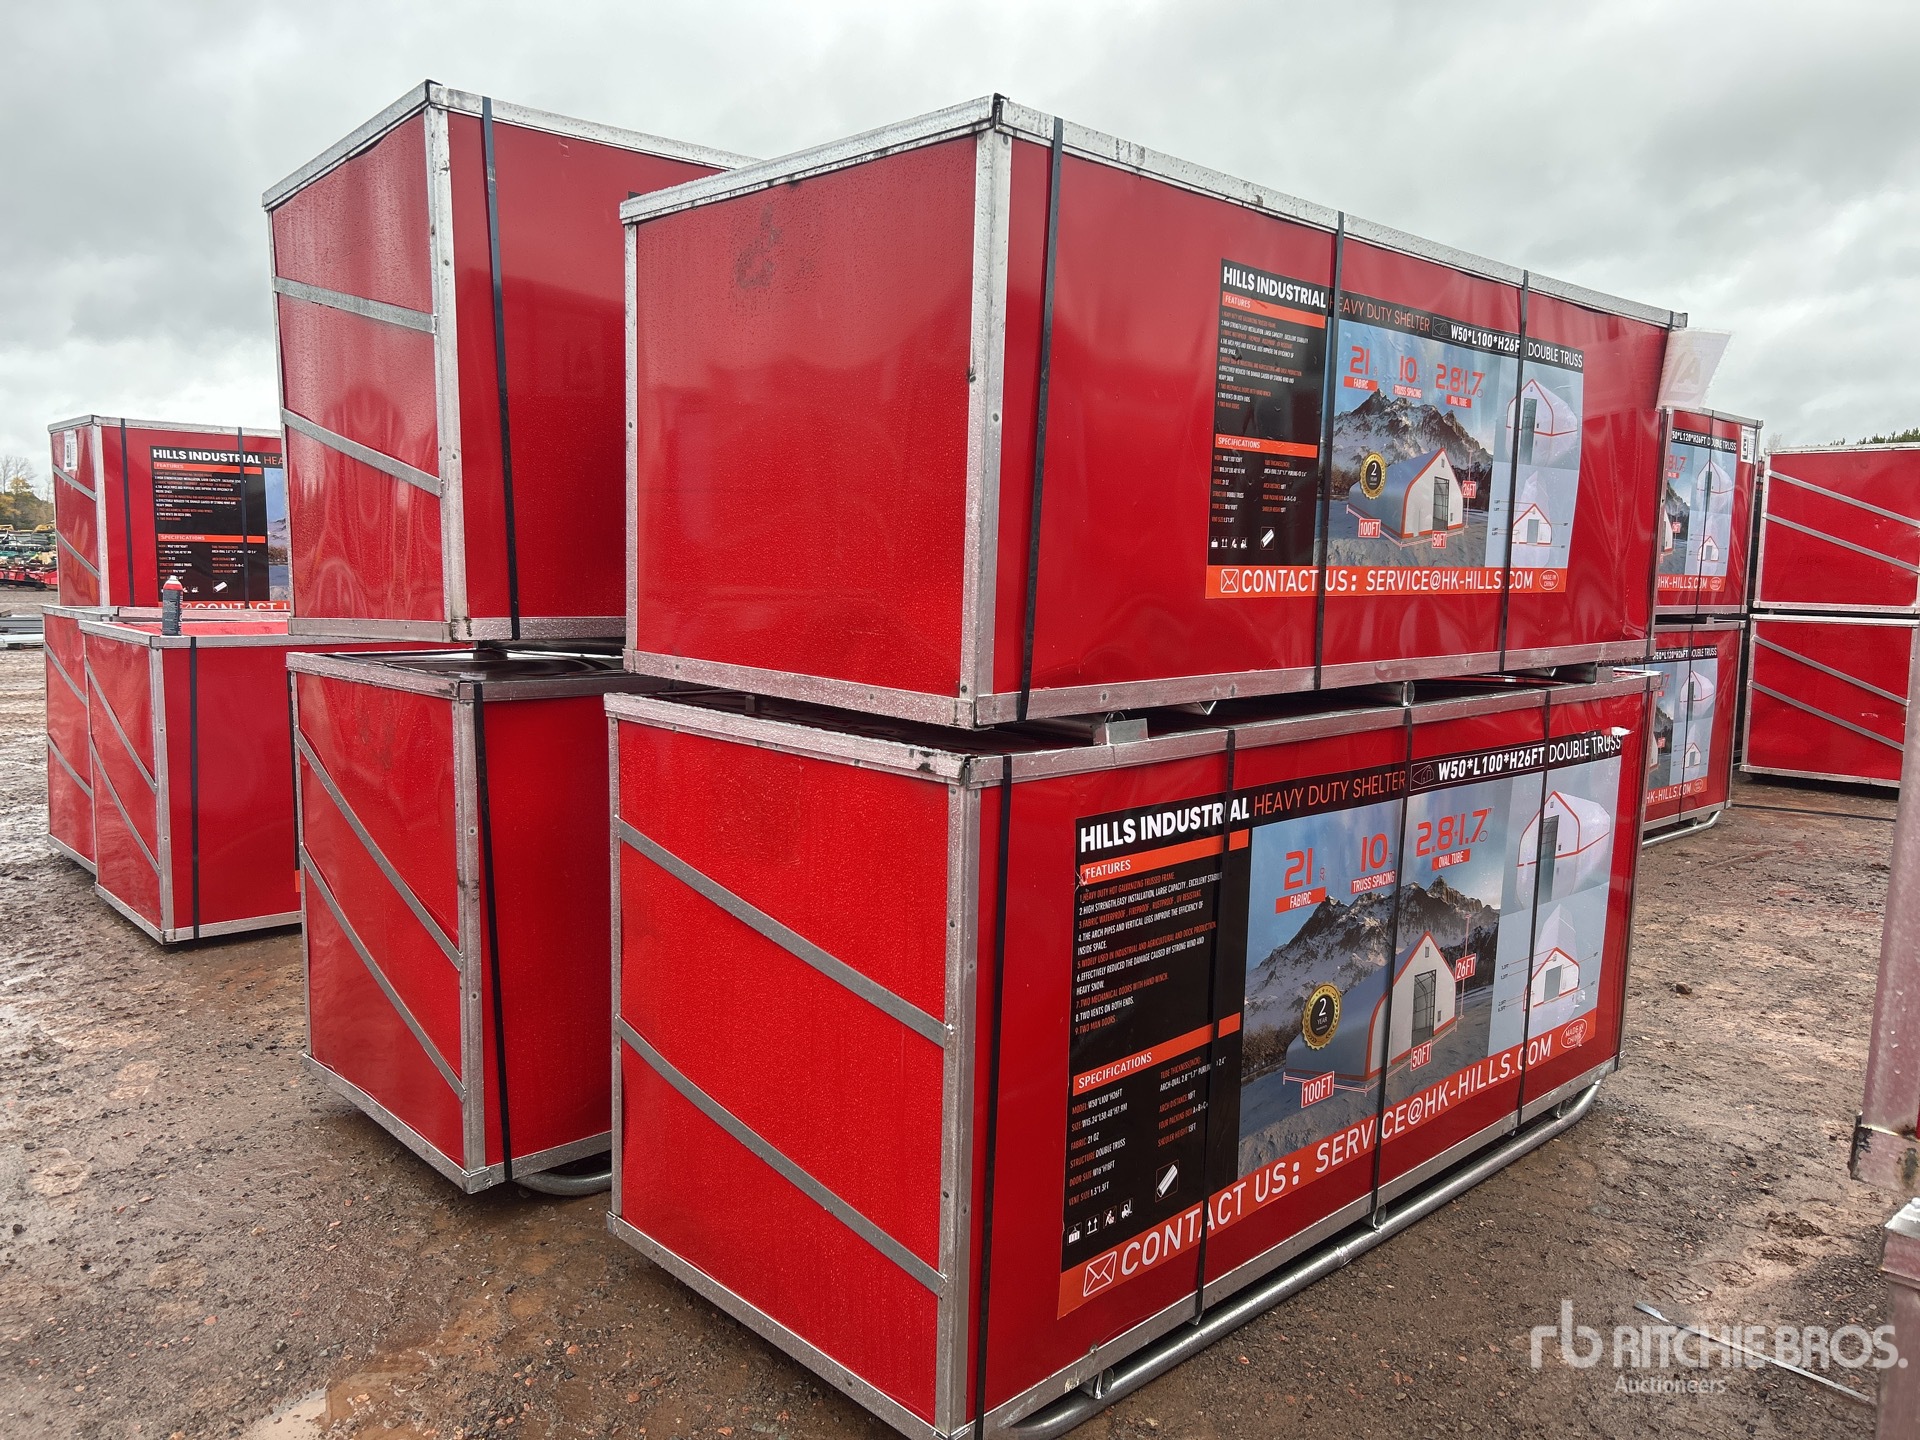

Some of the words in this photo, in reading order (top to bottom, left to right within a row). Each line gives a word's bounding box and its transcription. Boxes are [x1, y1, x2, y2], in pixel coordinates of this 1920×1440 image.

[1224, 266, 1254, 290] HILLS
[1256, 276, 1326, 308] INDUSTRIAL
[1366, 302, 1392, 324] DUTY
[1394, 308, 1430, 332] SHELTER
[1225, 295, 1251, 308] FEATURES
[1450, 324, 1520, 352] W50L100H26F
[1350, 346, 1370, 376] 21
[1528, 342, 1558, 362] DOUBLE
[1560, 350, 1583, 368] TRUSS
[1400, 356, 1417, 383] 10
[1218, 437, 1260, 449] SPECIFICATIONS
[1722, 440, 1737, 452] TRUSS
[153, 449, 186, 460] HILLS
[189, 451, 261, 464] INDUSTRIAL
[1371, 462, 1377, 476] 2
[1360, 521, 1380, 536] 100FT
[1432, 532, 1446, 548] 50FT
[1242, 569, 1318, 593] CONTACT
[1548, 738, 1590, 763] DOUBLE
[1592, 733, 1622, 756] TRUSS
[1080, 818, 1136, 852] HILLS
[1140, 797, 1250, 840] INDUSTRAL
[1254, 787, 1304, 816] HEAVY
[1308, 780, 1350, 806] DUTY
[1352, 770, 1406, 799] SHELTER
[1361, 833, 1388, 872] 10
[1438, 854, 1450, 868] OVAL
[1452, 850, 1464, 864] TUBE
[1085, 859, 1132, 878] FEATURES
[1284, 847, 1314, 890] 21
[1156, 886, 1168, 898] LARGE
[1188, 876, 1207, 888] EXCELLENT
[1352, 877, 1373, 893] TRUSS
[1372, 870, 1396, 888] SPACING
[1091, 928, 1104, 938] ARCH
[1104, 924, 1116, 936] PIPES
[1116, 922, 1125, 933] AND
[1125, 918, 1143, 930] VERTICAL
[1144, 914, 1154, 926] LEGS
[1154, 910, 1171, 922] IMPROVE
[1178, 902, 1198, 916] EFFICIENCY
[1198, 900, 1204, 909] OF
[1076, 966, 1106, 982] 6.EFFECTIVELY
[1106, 960, 1126, 974] REDUCED
[1126, 958, 1134, 969] THE
[1134, 952, 1150, 966] DAMAGE
[1150, 947, 1166, 960] CAUSED
[1166, 946, 1171, 956] BY
[1172, 940, 1186, 954] STRONG
[1186, 938, 1197, 949] WIND
[1197, 936, 1205, 946] AND
[1078, 944, 1092, 956] INSIDE
[1456, 956, 1476, 979] 26FT
[1076, 984, 1090, 996] HEAVY
[1091, 990, 1118, 1006] MECHANICAL
[1118, 984, 1132, 996] DOORS
[1132, 980, 1144, 992] WITH
[1076, 1010, 1090, 1022] 8.TWO
[1090, 1005, 1104, 1018] VENTS
[1104, 1003, 1112, 1014] ON
[1112, 999, 1122, 1012] BOTH
[1319, 998, 1326, 1016] 2
[1090, 1020, 1101, 1031] MAN
[1317, 1016, 1328, 1025] YEAR
[1412, 1043, 1432, 1068] 50FT
[1078, 1052, 1152, 1089] SPECIFICATIONS
[1304, 1074, 1334, 1104] 100FT
[1112, 1138, 1126, 1150] TRUSS
[1122, 1182, 1247, 1276] CONTACT
[1315, 1034, 1552, 1174] SERVICE@HK-HILLS.COM
[1070, 1174, 1082, 1187] DOOR
[1069, 1194, 1080, 1206] VENT
